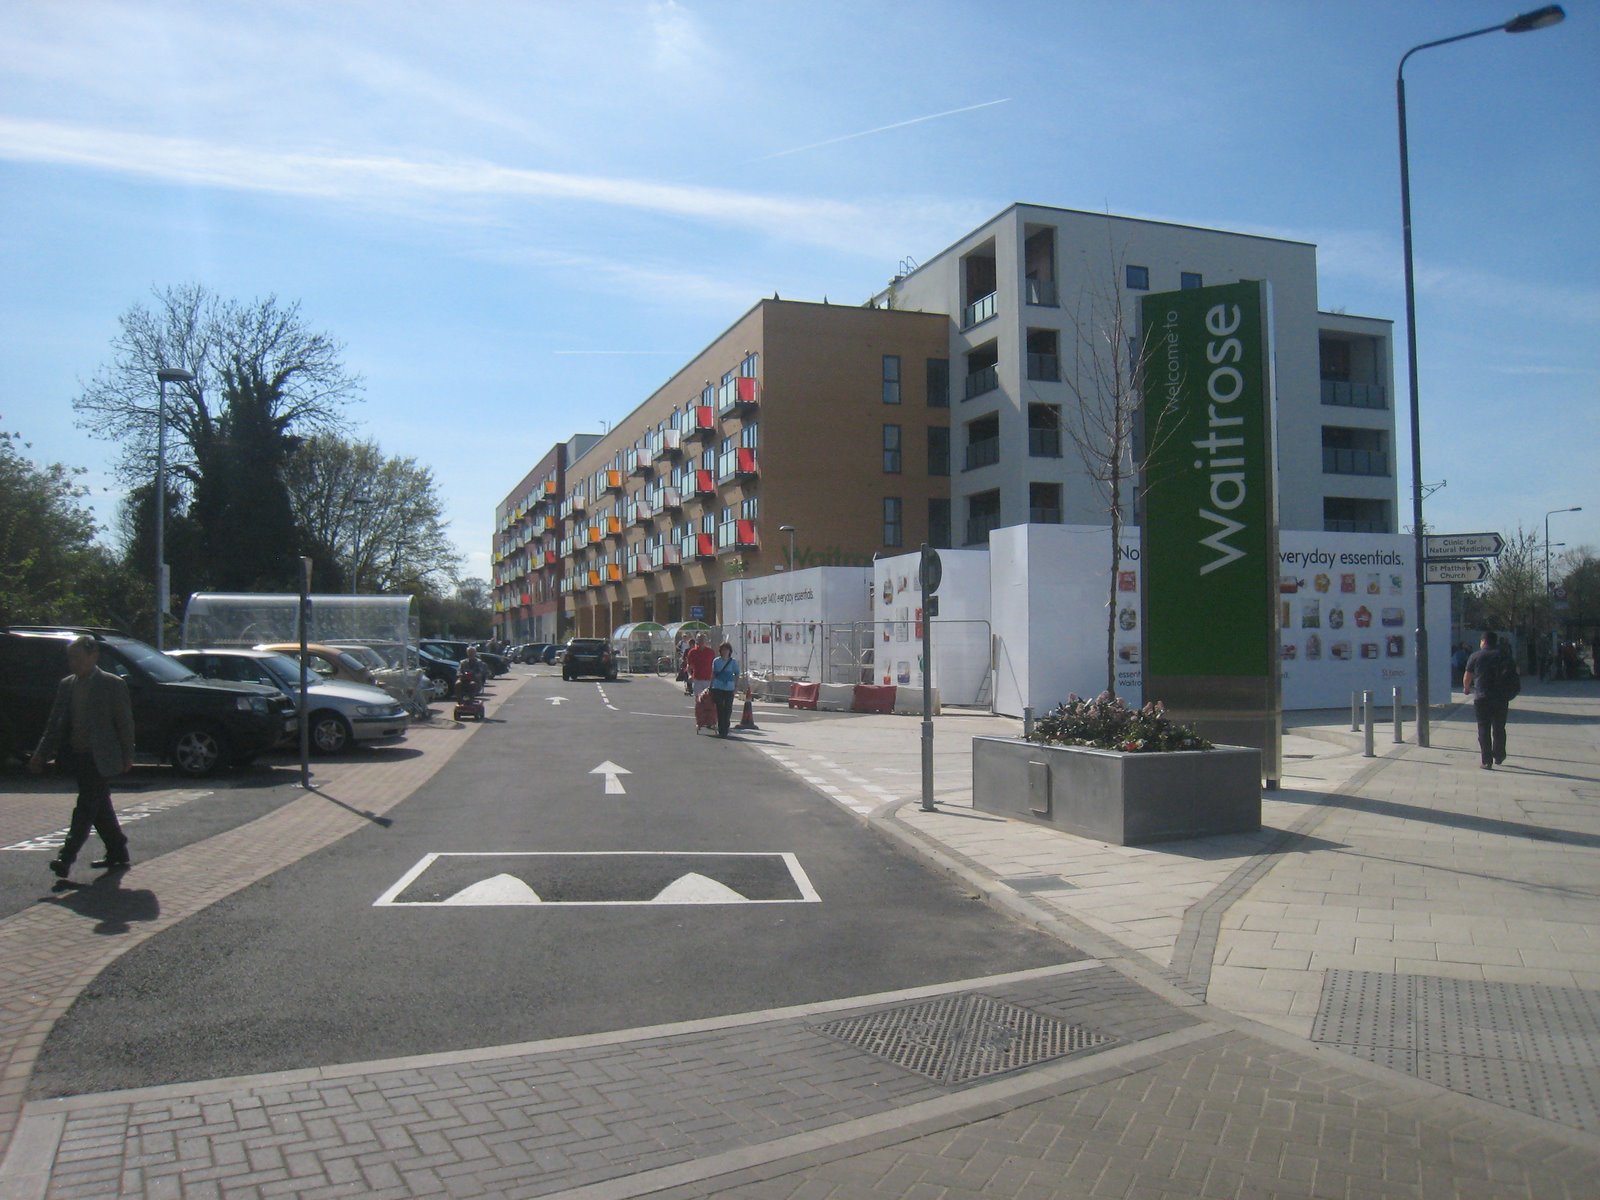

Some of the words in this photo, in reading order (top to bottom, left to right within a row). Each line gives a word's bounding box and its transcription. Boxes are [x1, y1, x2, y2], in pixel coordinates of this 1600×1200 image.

[1162, 310, 1178, 330] to
[1192, 303, 1247, 576] Waitrose
[1279, 548, 1336, 569] veryday
[1340, 550, 1404, 566] essentials.
